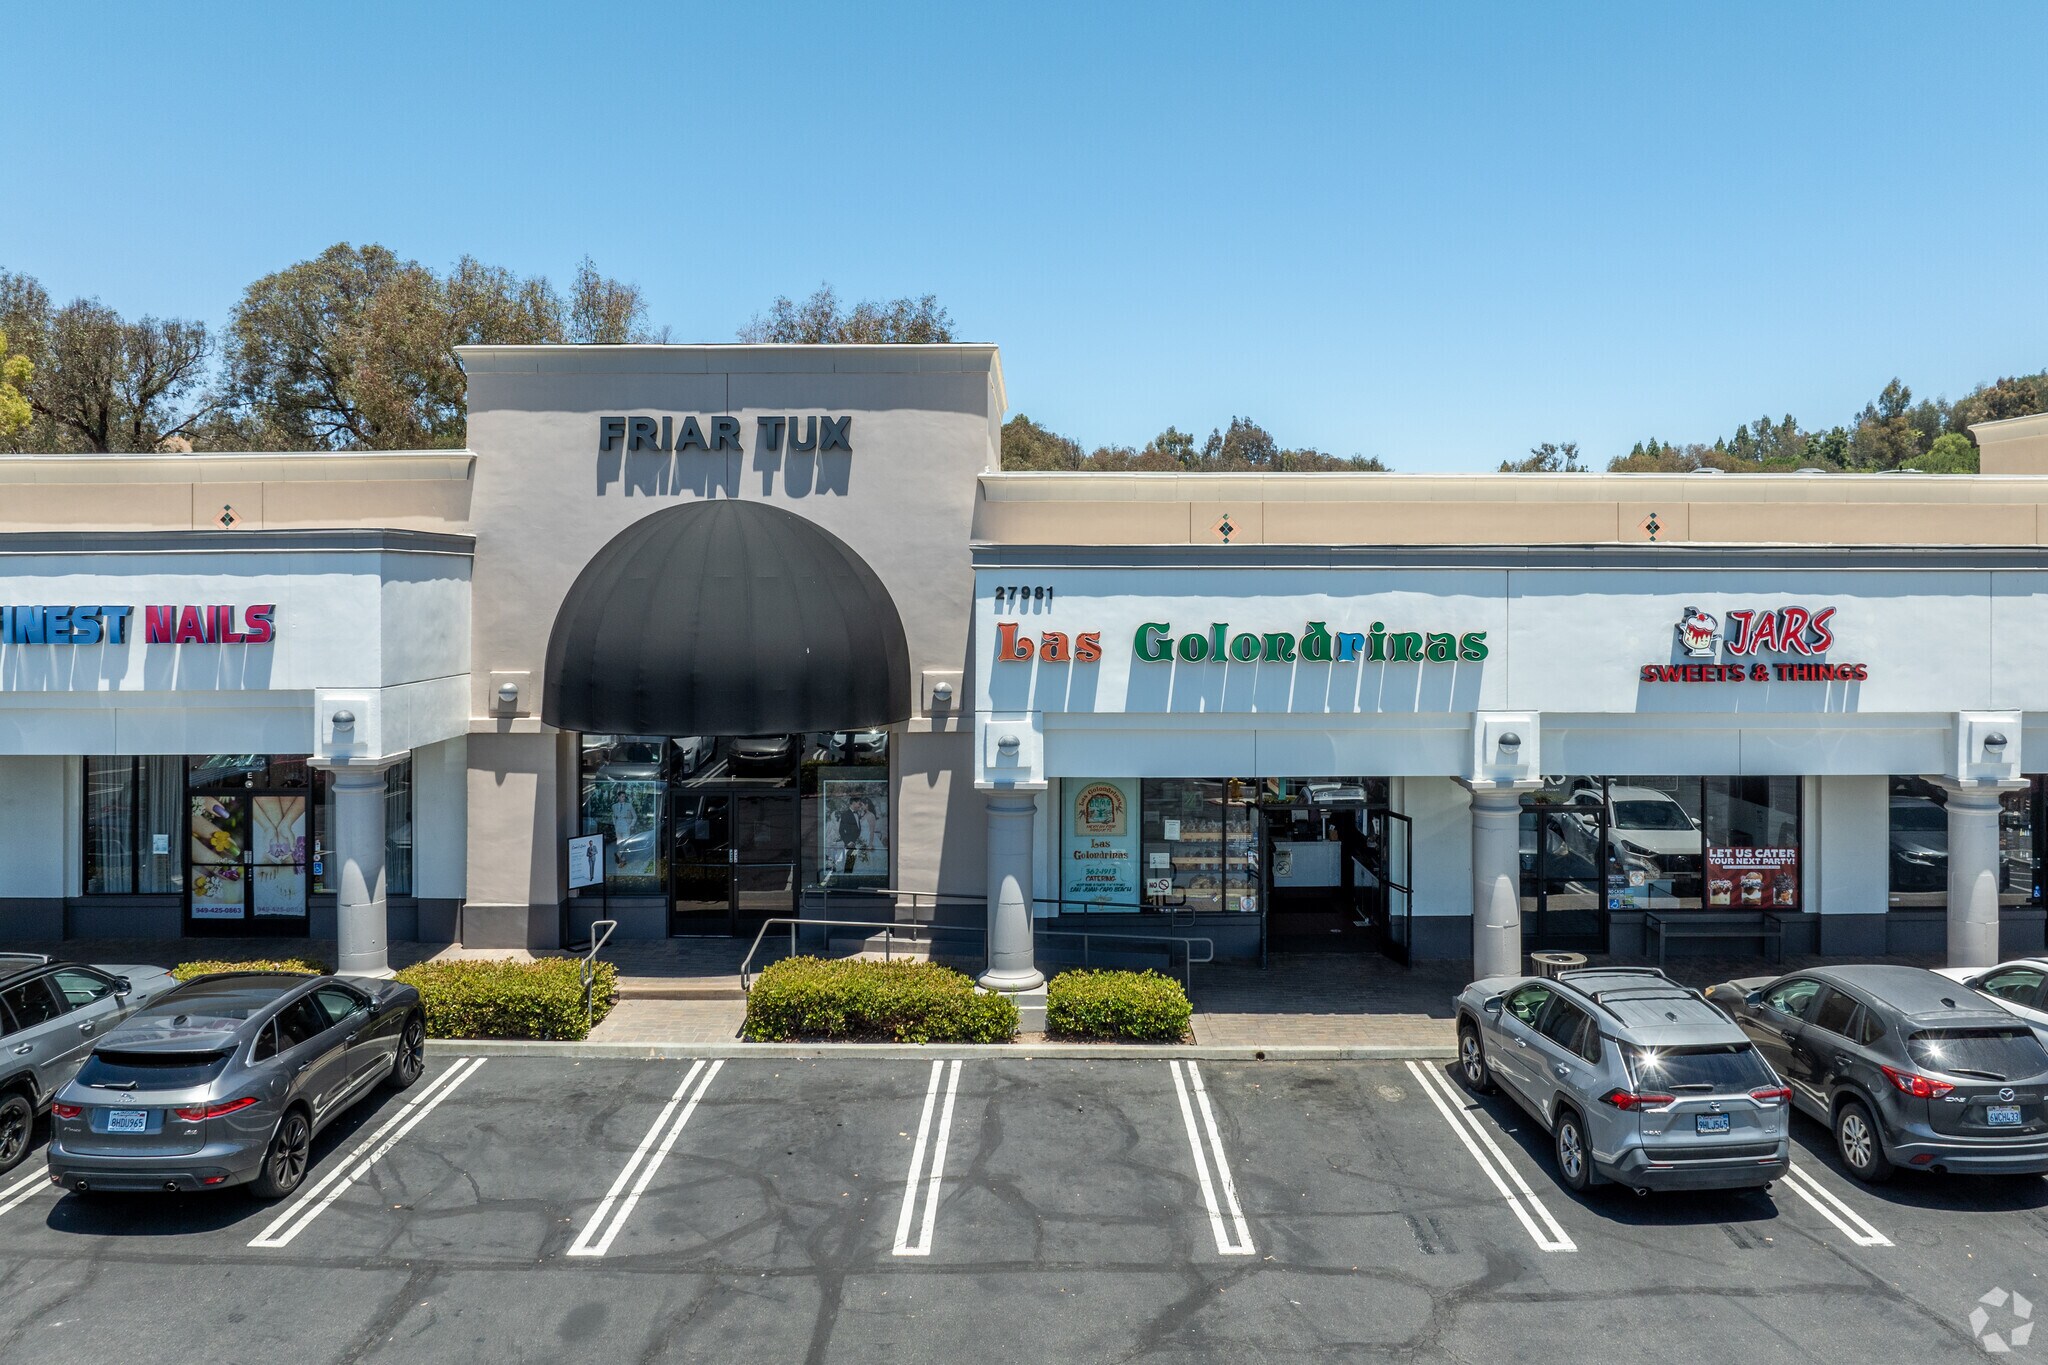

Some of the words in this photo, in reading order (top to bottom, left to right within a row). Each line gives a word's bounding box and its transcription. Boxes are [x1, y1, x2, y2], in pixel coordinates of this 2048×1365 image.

[600, 415, 744, 451] FRIAR
[757, 415, 853, 452] TUX
[995, 585, 1053, 600] 27981
[0, 605, 134, 645] INEST
[145, 604, 276, 645] NAILS
[1725, 606, 1837, 656] JARS
[997, 621, 1103, 663] Las
[1133, 620, 1489, 664] Golondrinas
[1640, 663, 1746, 683] SWEETS
[1749, 663, 1770, 682] &
[1772, 662, 1868, 682] THINGS
[247, 771, 253, 779] E
[731, 774, 737, 782] F
[1090, 838, 1111, 849] Las
[1074, 850, 1129, 860] Golondrinas
[1709, 848, 1733, 858] LET
[1735, 848, 1752, 858] US
[1754, 848, 1796, 858] CATER
[1709, 857, 1734, 865] YOUR
[1735, 857, 1761, 865] NEXT
[1762, 857, 1796, 865] PARTY!
[111, 1117, 143, 1128] 8HDU965
